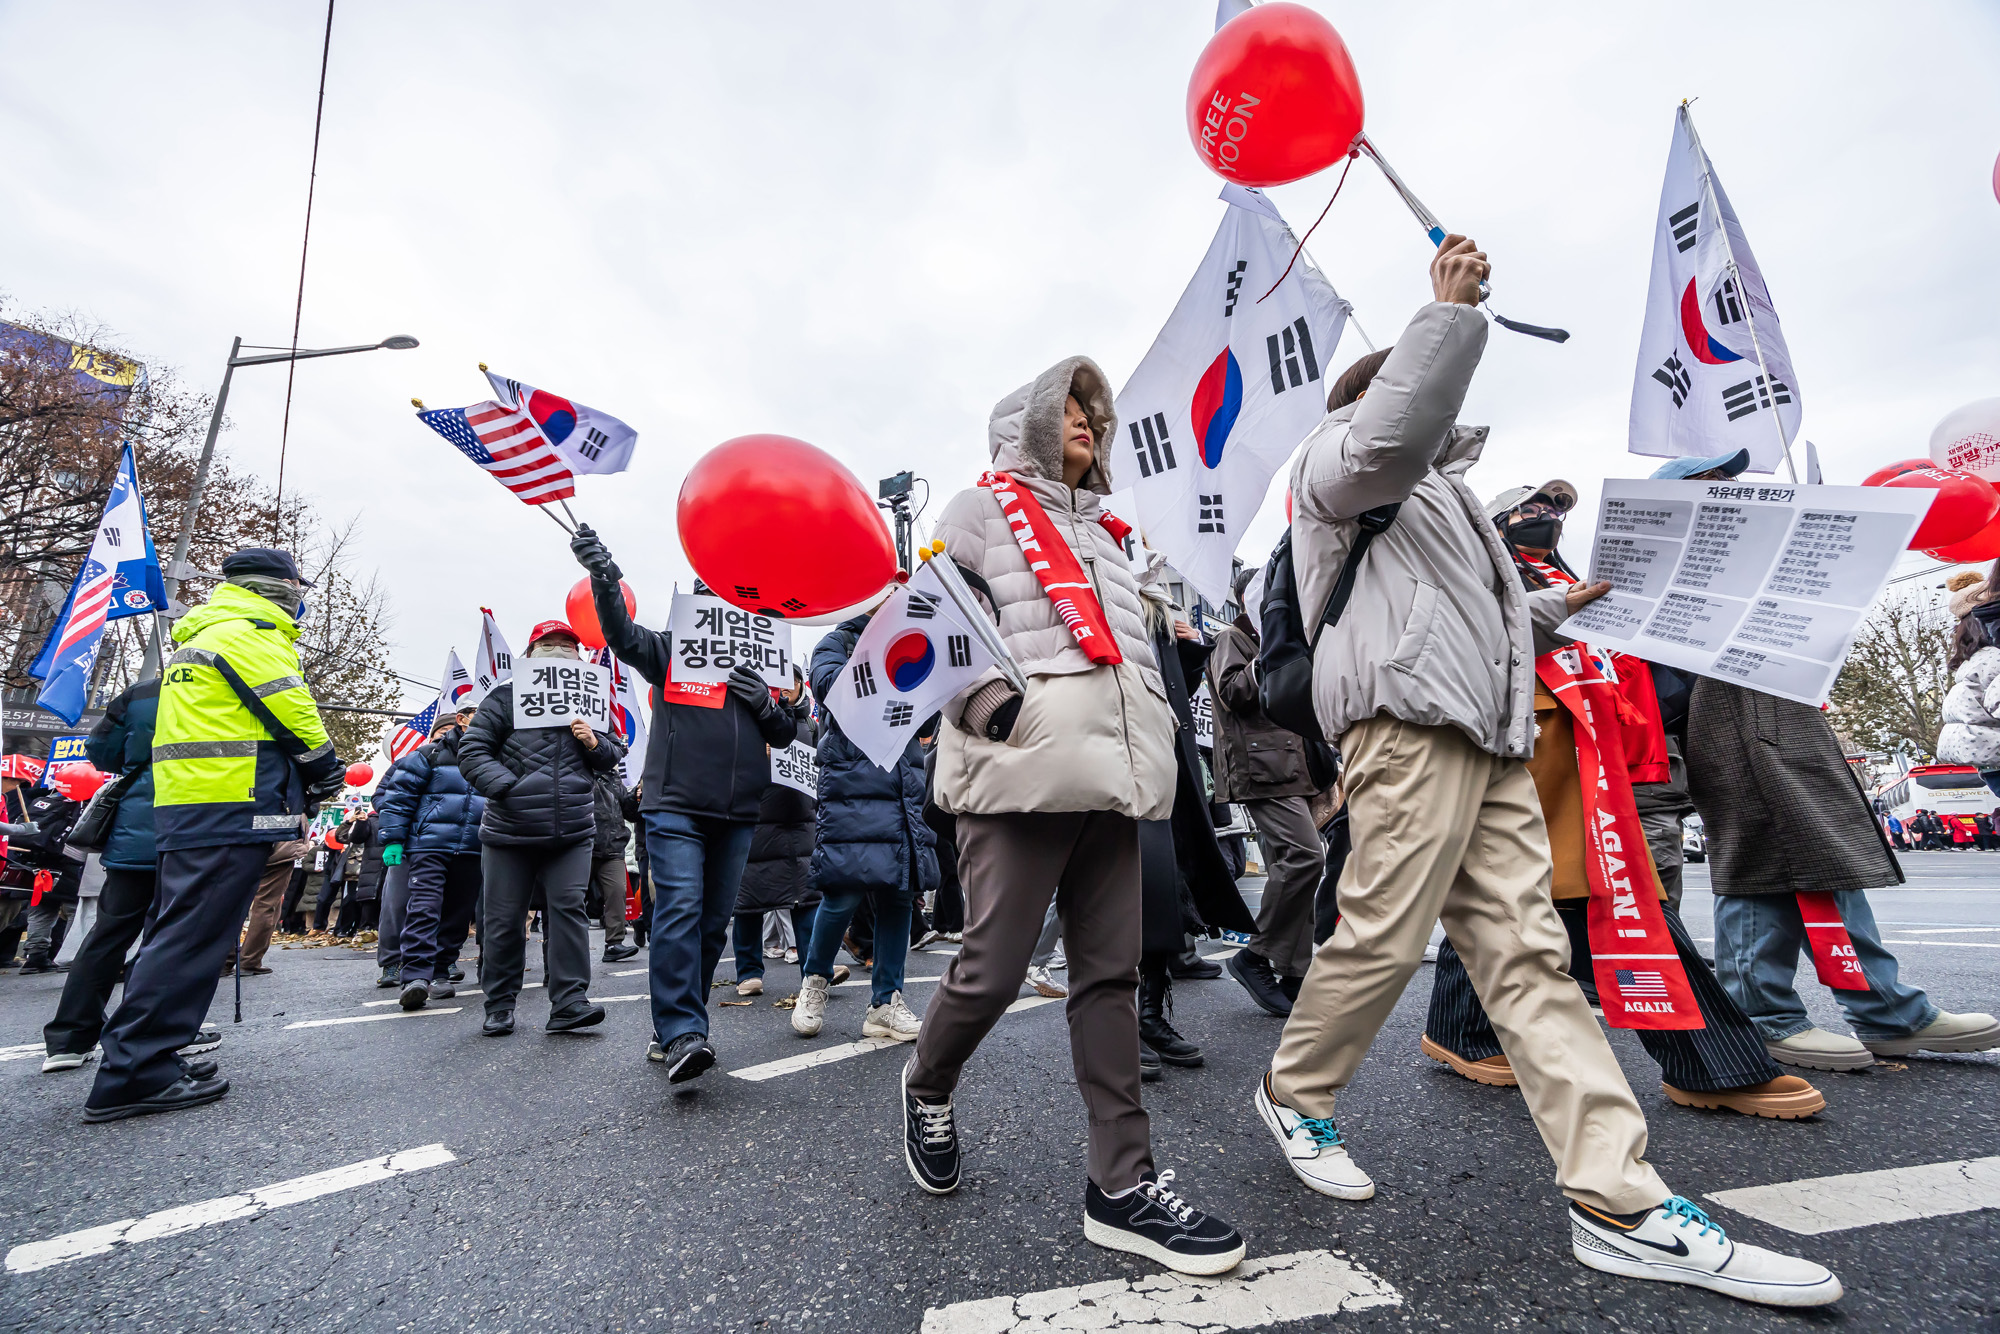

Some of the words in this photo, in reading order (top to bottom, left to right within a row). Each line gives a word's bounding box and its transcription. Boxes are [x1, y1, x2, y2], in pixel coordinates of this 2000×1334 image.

[1200, 90, 1231, 157] FREE
[1218, 92, 1260, 172] YOON
[1948, 441, 1973, 456] 재명아
[1707, 486, 1755, 500] 자유대학
[1757, 488, 1795, 502] 행진가
[1697, 522, 1715, 530] 한남동
[1618, 547, 1641, 555] 사랑하는
[1813, 542, 1828, 550] 정신
[1680, 571, 1712, 579] 자유대한민국
[1778, 567, 1805, 575] 부정선거
[1668, 593, 1689, 601] 대한민국
[694, 607, 775, 644] 계엄은
[679, 638, 788, 677] 정당했다
[1745, 652, 1766, 661] 민주당
[1740, 660, 1761, 670] 민주당
[532, 666, 600, 694] 계엄은
[679, 683, 710, 696] 2025
[520, 691, 607, 721] 정당했다
[53, 739, 88, 759] 법치
[775, 758, 818, 791] 정당했
[1597, 808, 1642, 920] AGAIN
[1598, 854, 1610, 889] AGAIN
[1624, 1001, 1675, 1013] AGAIN
